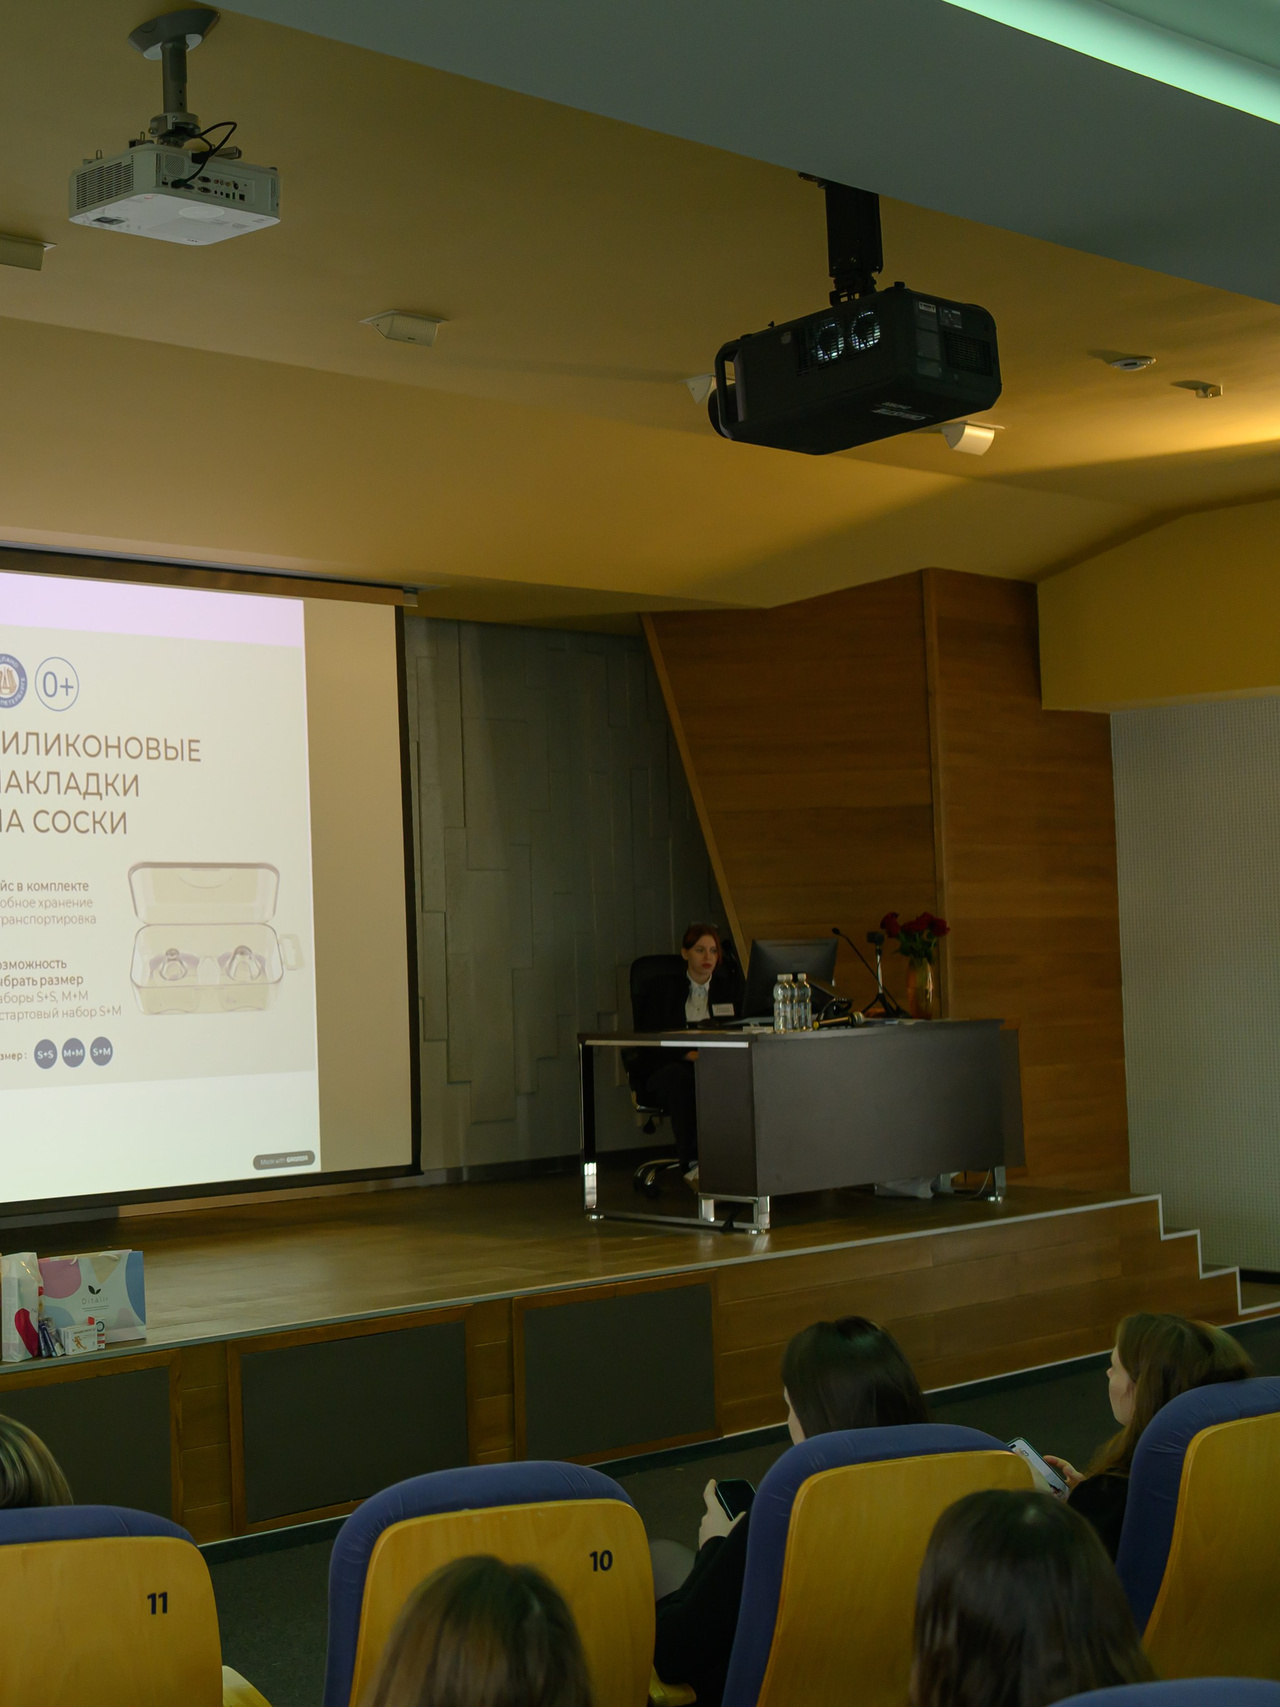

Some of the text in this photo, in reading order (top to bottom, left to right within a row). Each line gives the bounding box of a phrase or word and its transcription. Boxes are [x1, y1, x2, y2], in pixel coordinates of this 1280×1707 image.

[43, 671, 74, 698] 0+
[33, 810, 127, 835] СОСКИ
[17, 882, 23, 892] в
[27, 881, 89, 892] комплекте
[38, 898, 93, 910] хранение
[40, 975, 84, 988] размер
[36, 991, 59, 1004] S+S,
[61, 990, 89, 1001] M+M
[61, 1007, 97, 1019] набор
[99, 1005, 122, 1016] S+M
[37, 1051, 54, 1060] S+S
[63, 1048, 84, 1057] M+M
[92, 1047, 111, 1056] S+M
[589, 1550, 613, 1572] 10
[147, 1591, 168, 1615] 11
